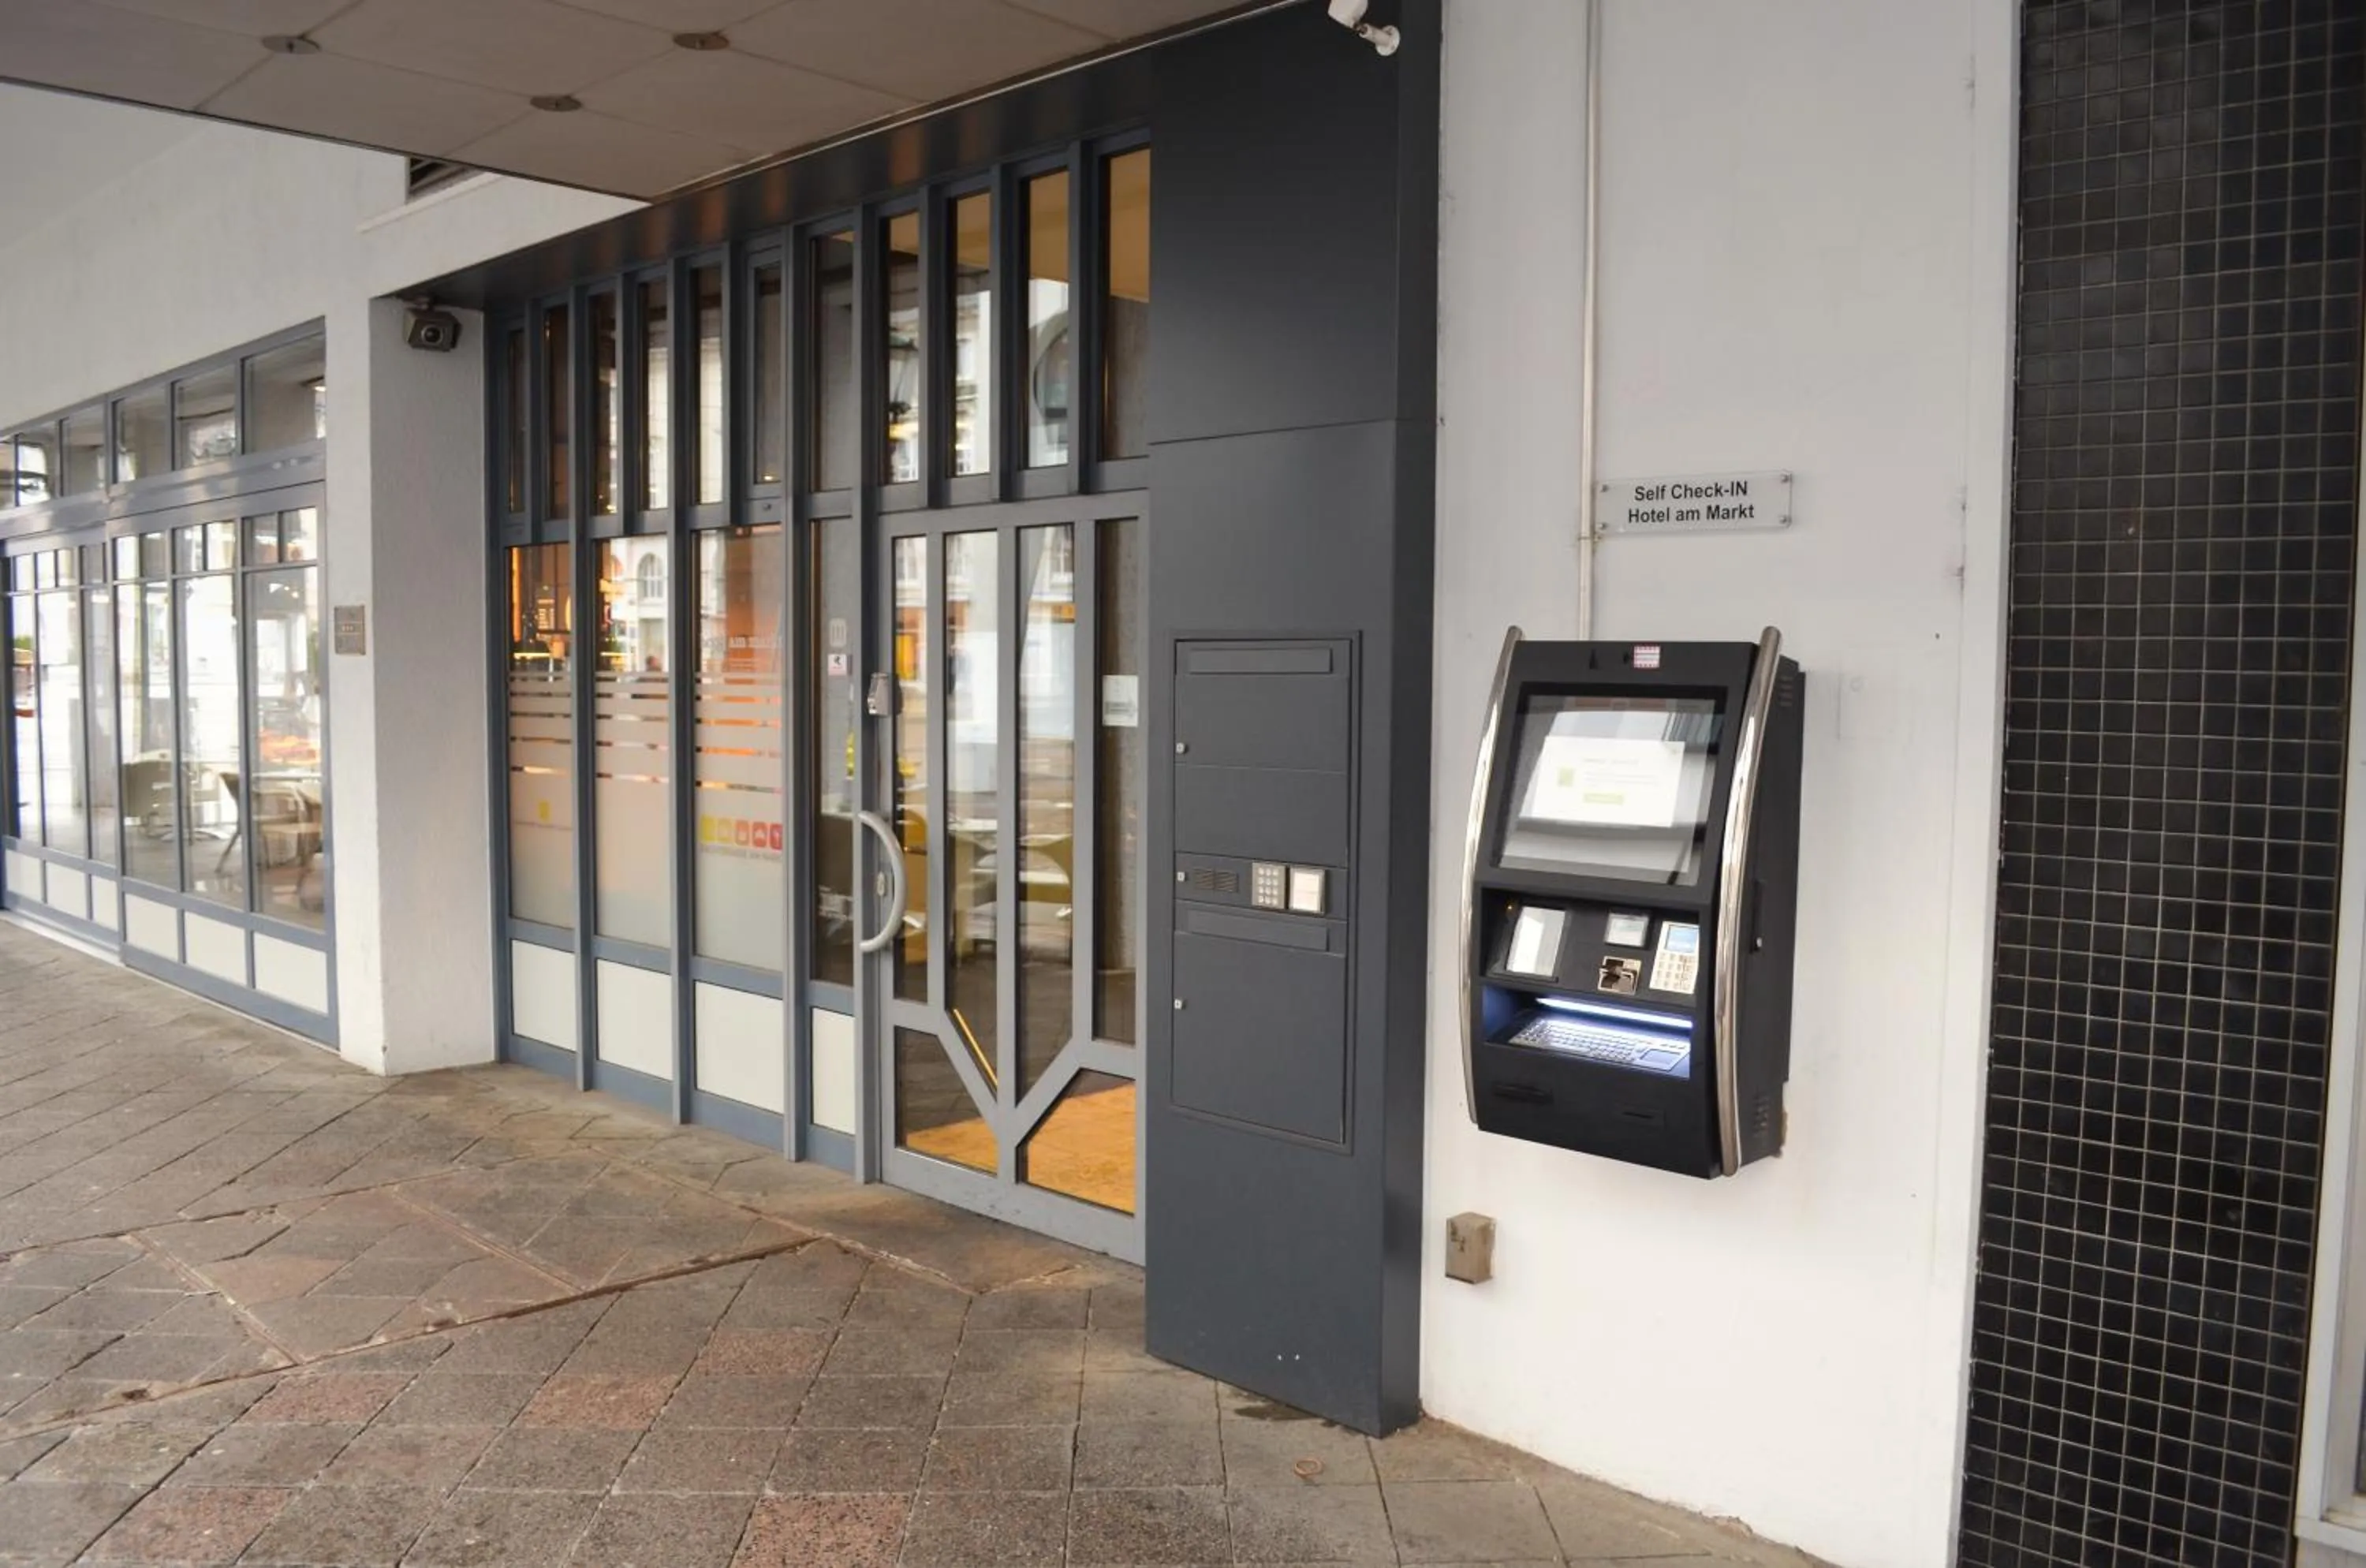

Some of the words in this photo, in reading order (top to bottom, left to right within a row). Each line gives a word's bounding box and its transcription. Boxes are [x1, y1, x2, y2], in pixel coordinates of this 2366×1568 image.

[1634, 485, 1666, 501] Self
[1671, 480, 1748, 499] Check-IN
[1629, 507, 1670, 523] Hotel
[1675, 509, 1700, 521] am
[1706, 503, 1755, 520] Markt
